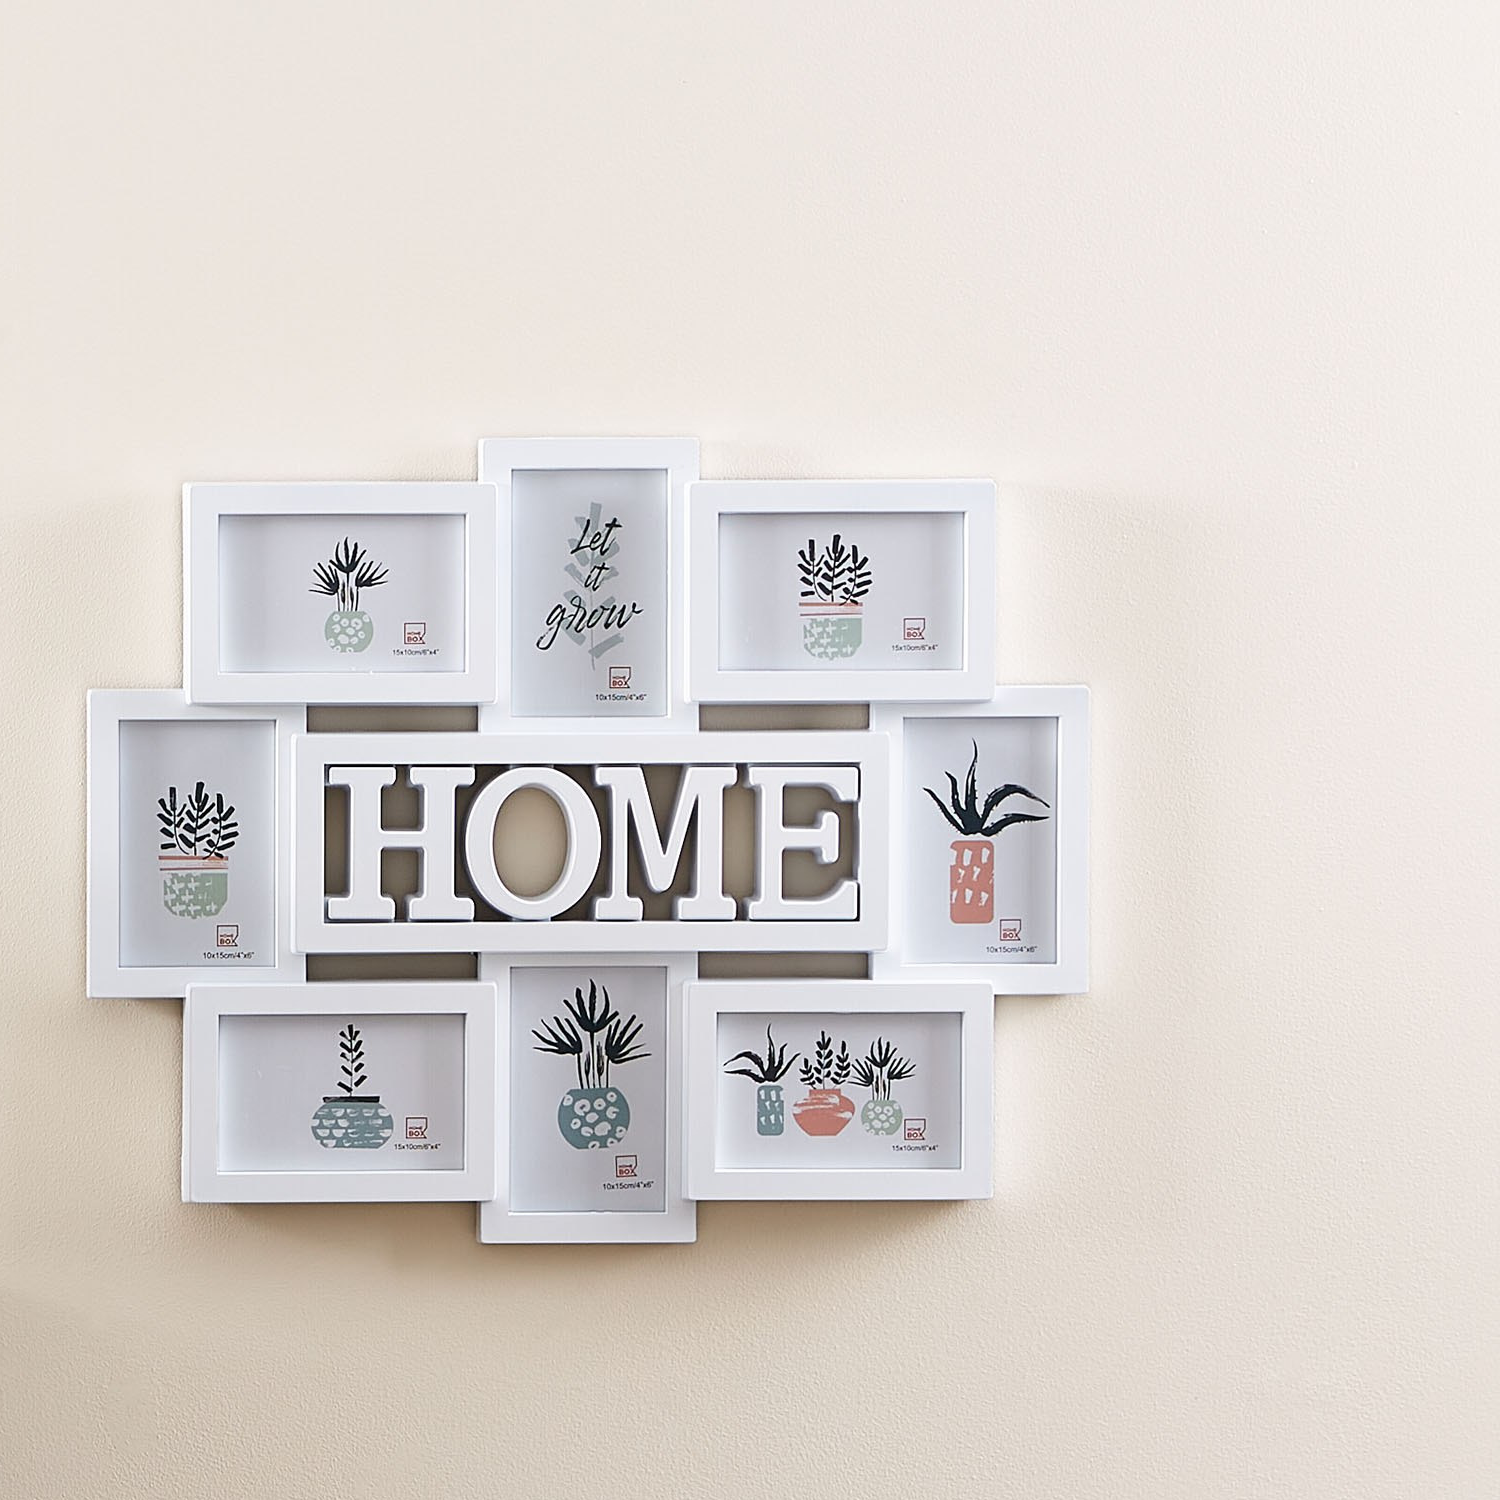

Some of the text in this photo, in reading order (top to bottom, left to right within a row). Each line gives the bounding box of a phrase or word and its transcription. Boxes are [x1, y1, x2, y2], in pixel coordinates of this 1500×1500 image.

[570, 517, 623, 556] Let
[584, 562, 610, 591] it
[536, 595, 644, 650] grow
[328, 767, 860, 920] HOME
